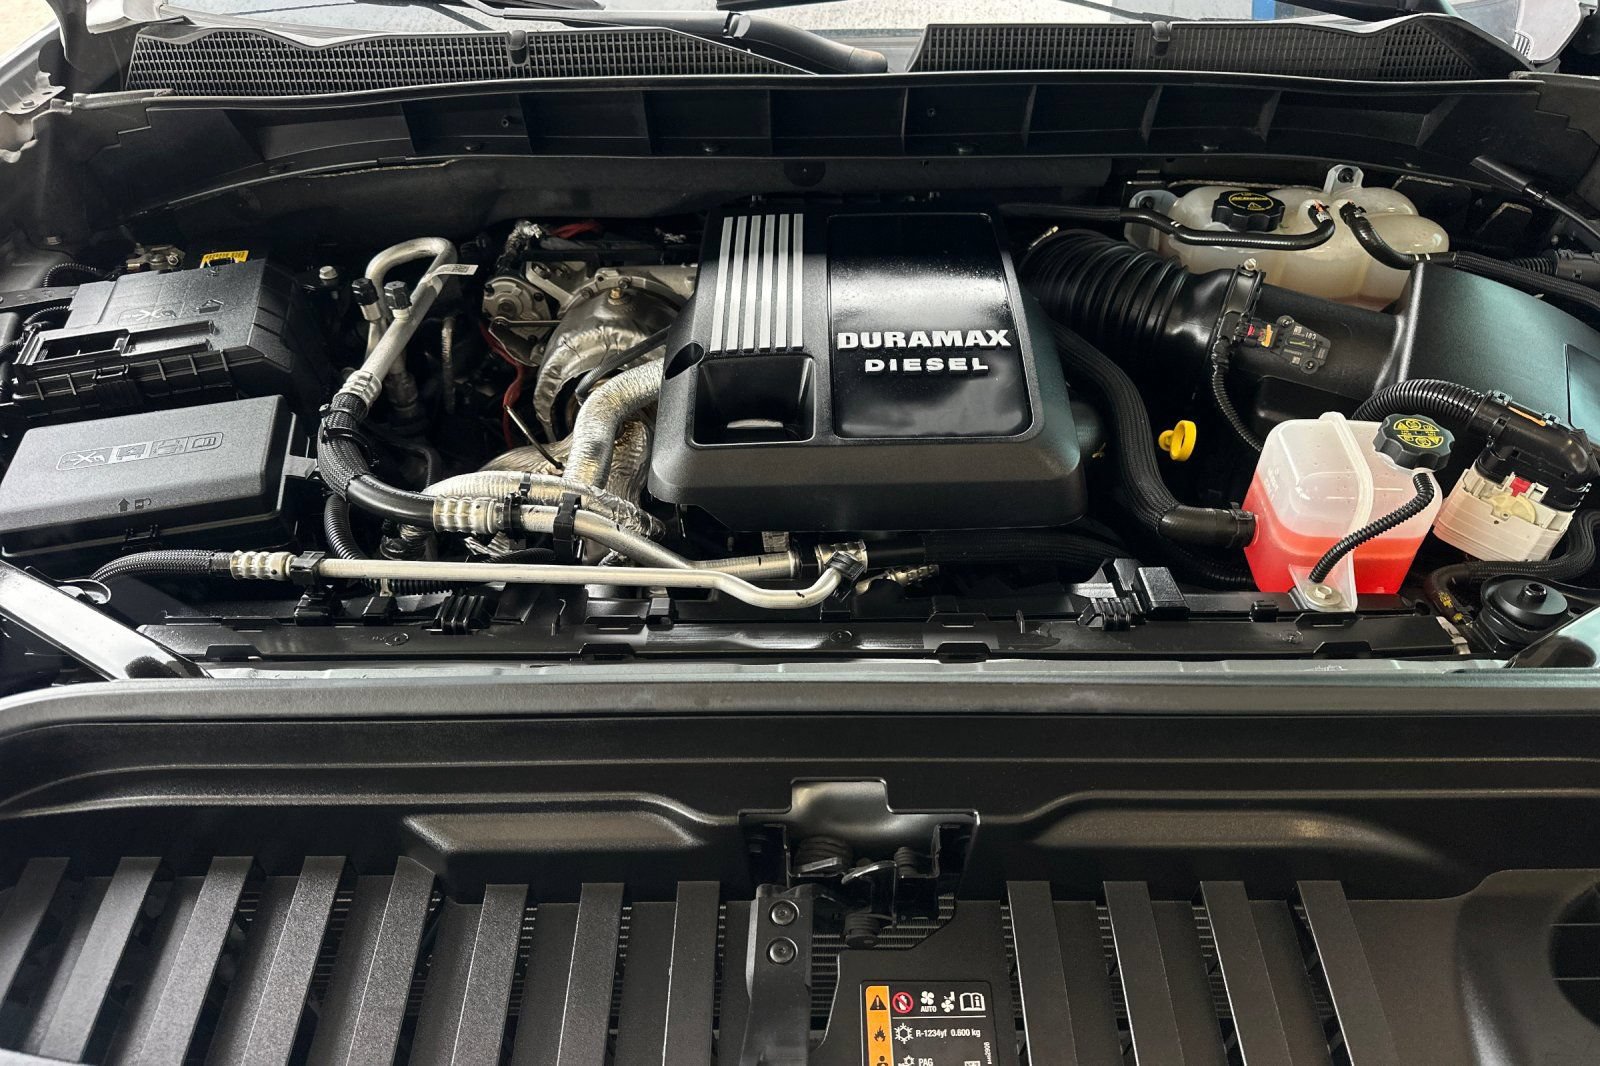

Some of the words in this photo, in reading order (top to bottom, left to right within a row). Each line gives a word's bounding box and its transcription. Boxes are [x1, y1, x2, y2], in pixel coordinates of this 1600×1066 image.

[837, 330, 1011, 350] DURAMAX
[865, 358, 989, 373] DIESEL
[915, 1029, 947, 1038] R-1234yf
[950, 1029, 971, 1037] 0.600
[971, 1029, 981, 1037] kg
[918, 1058, 934, 1066] PAG
